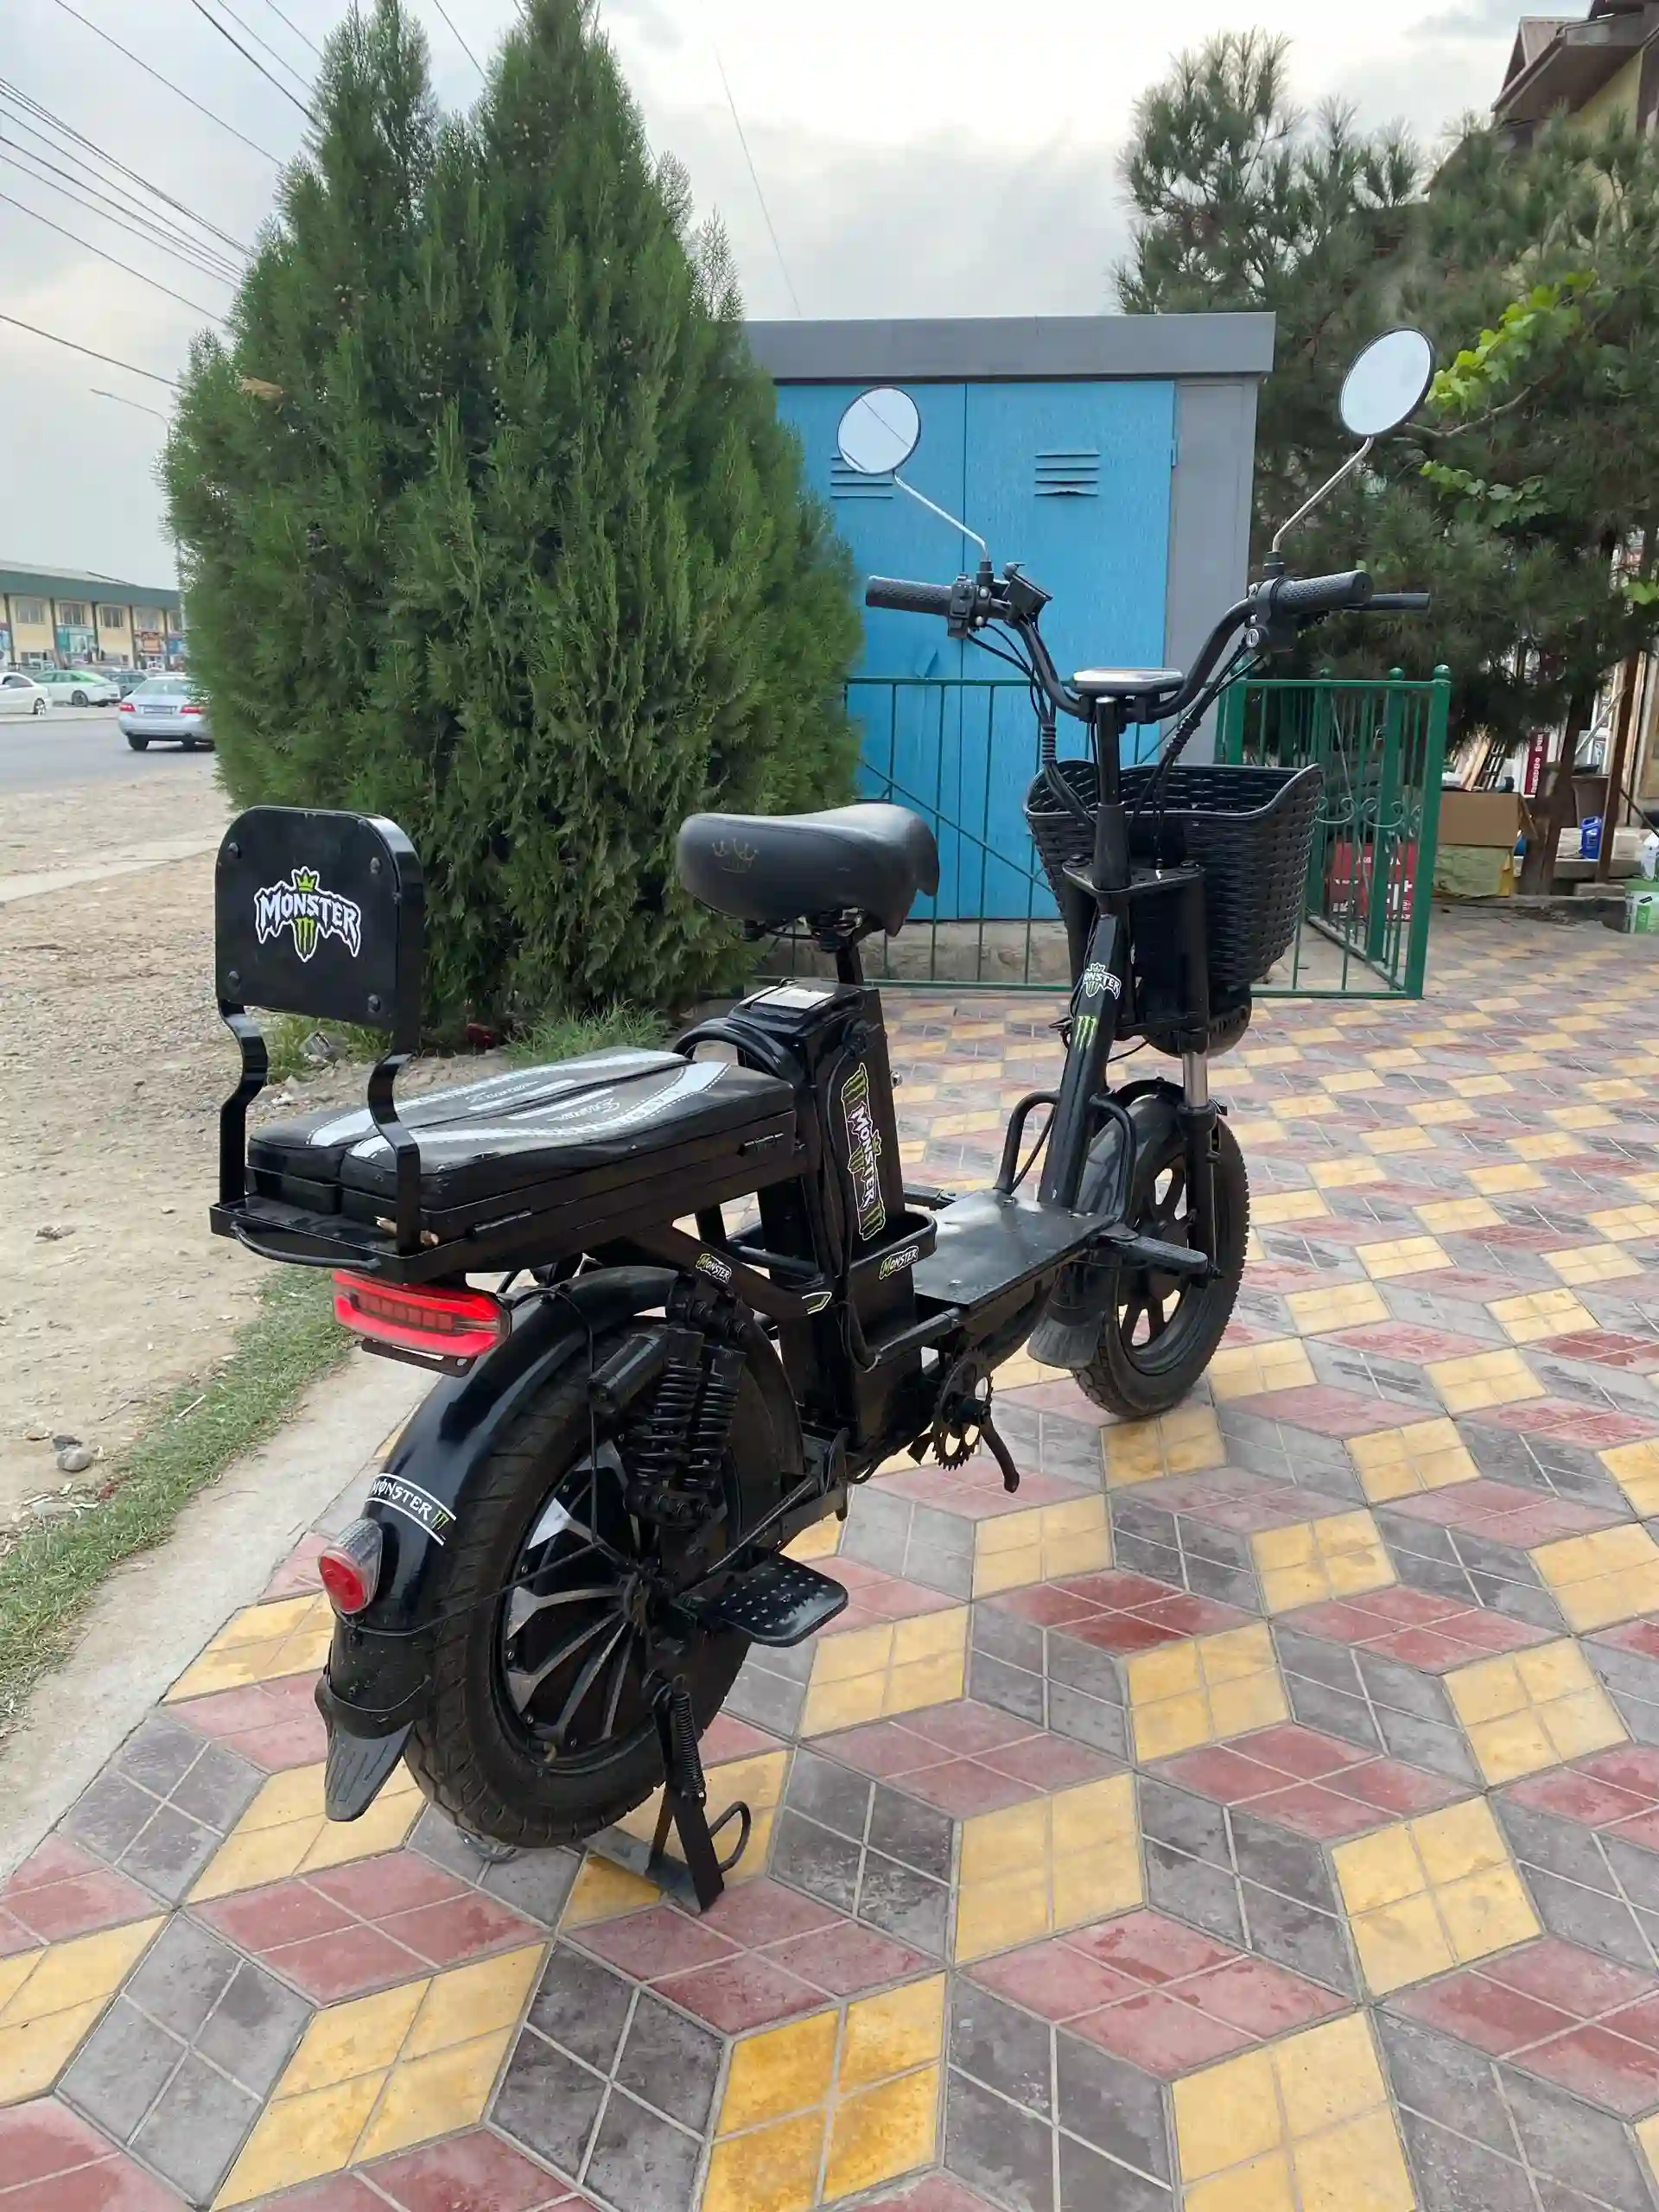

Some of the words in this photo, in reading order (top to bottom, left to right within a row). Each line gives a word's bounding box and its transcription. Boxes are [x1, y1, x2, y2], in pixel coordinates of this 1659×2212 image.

[259, 889, 358, 947] MONSTER
[1084, 971, 1121, 995] ONSTER
[849, 1105, 874, 1210] MONSTER
[697, 1255, 731, 1281] MONSTER
[880, 1248, 918, 1277] MONSTER
